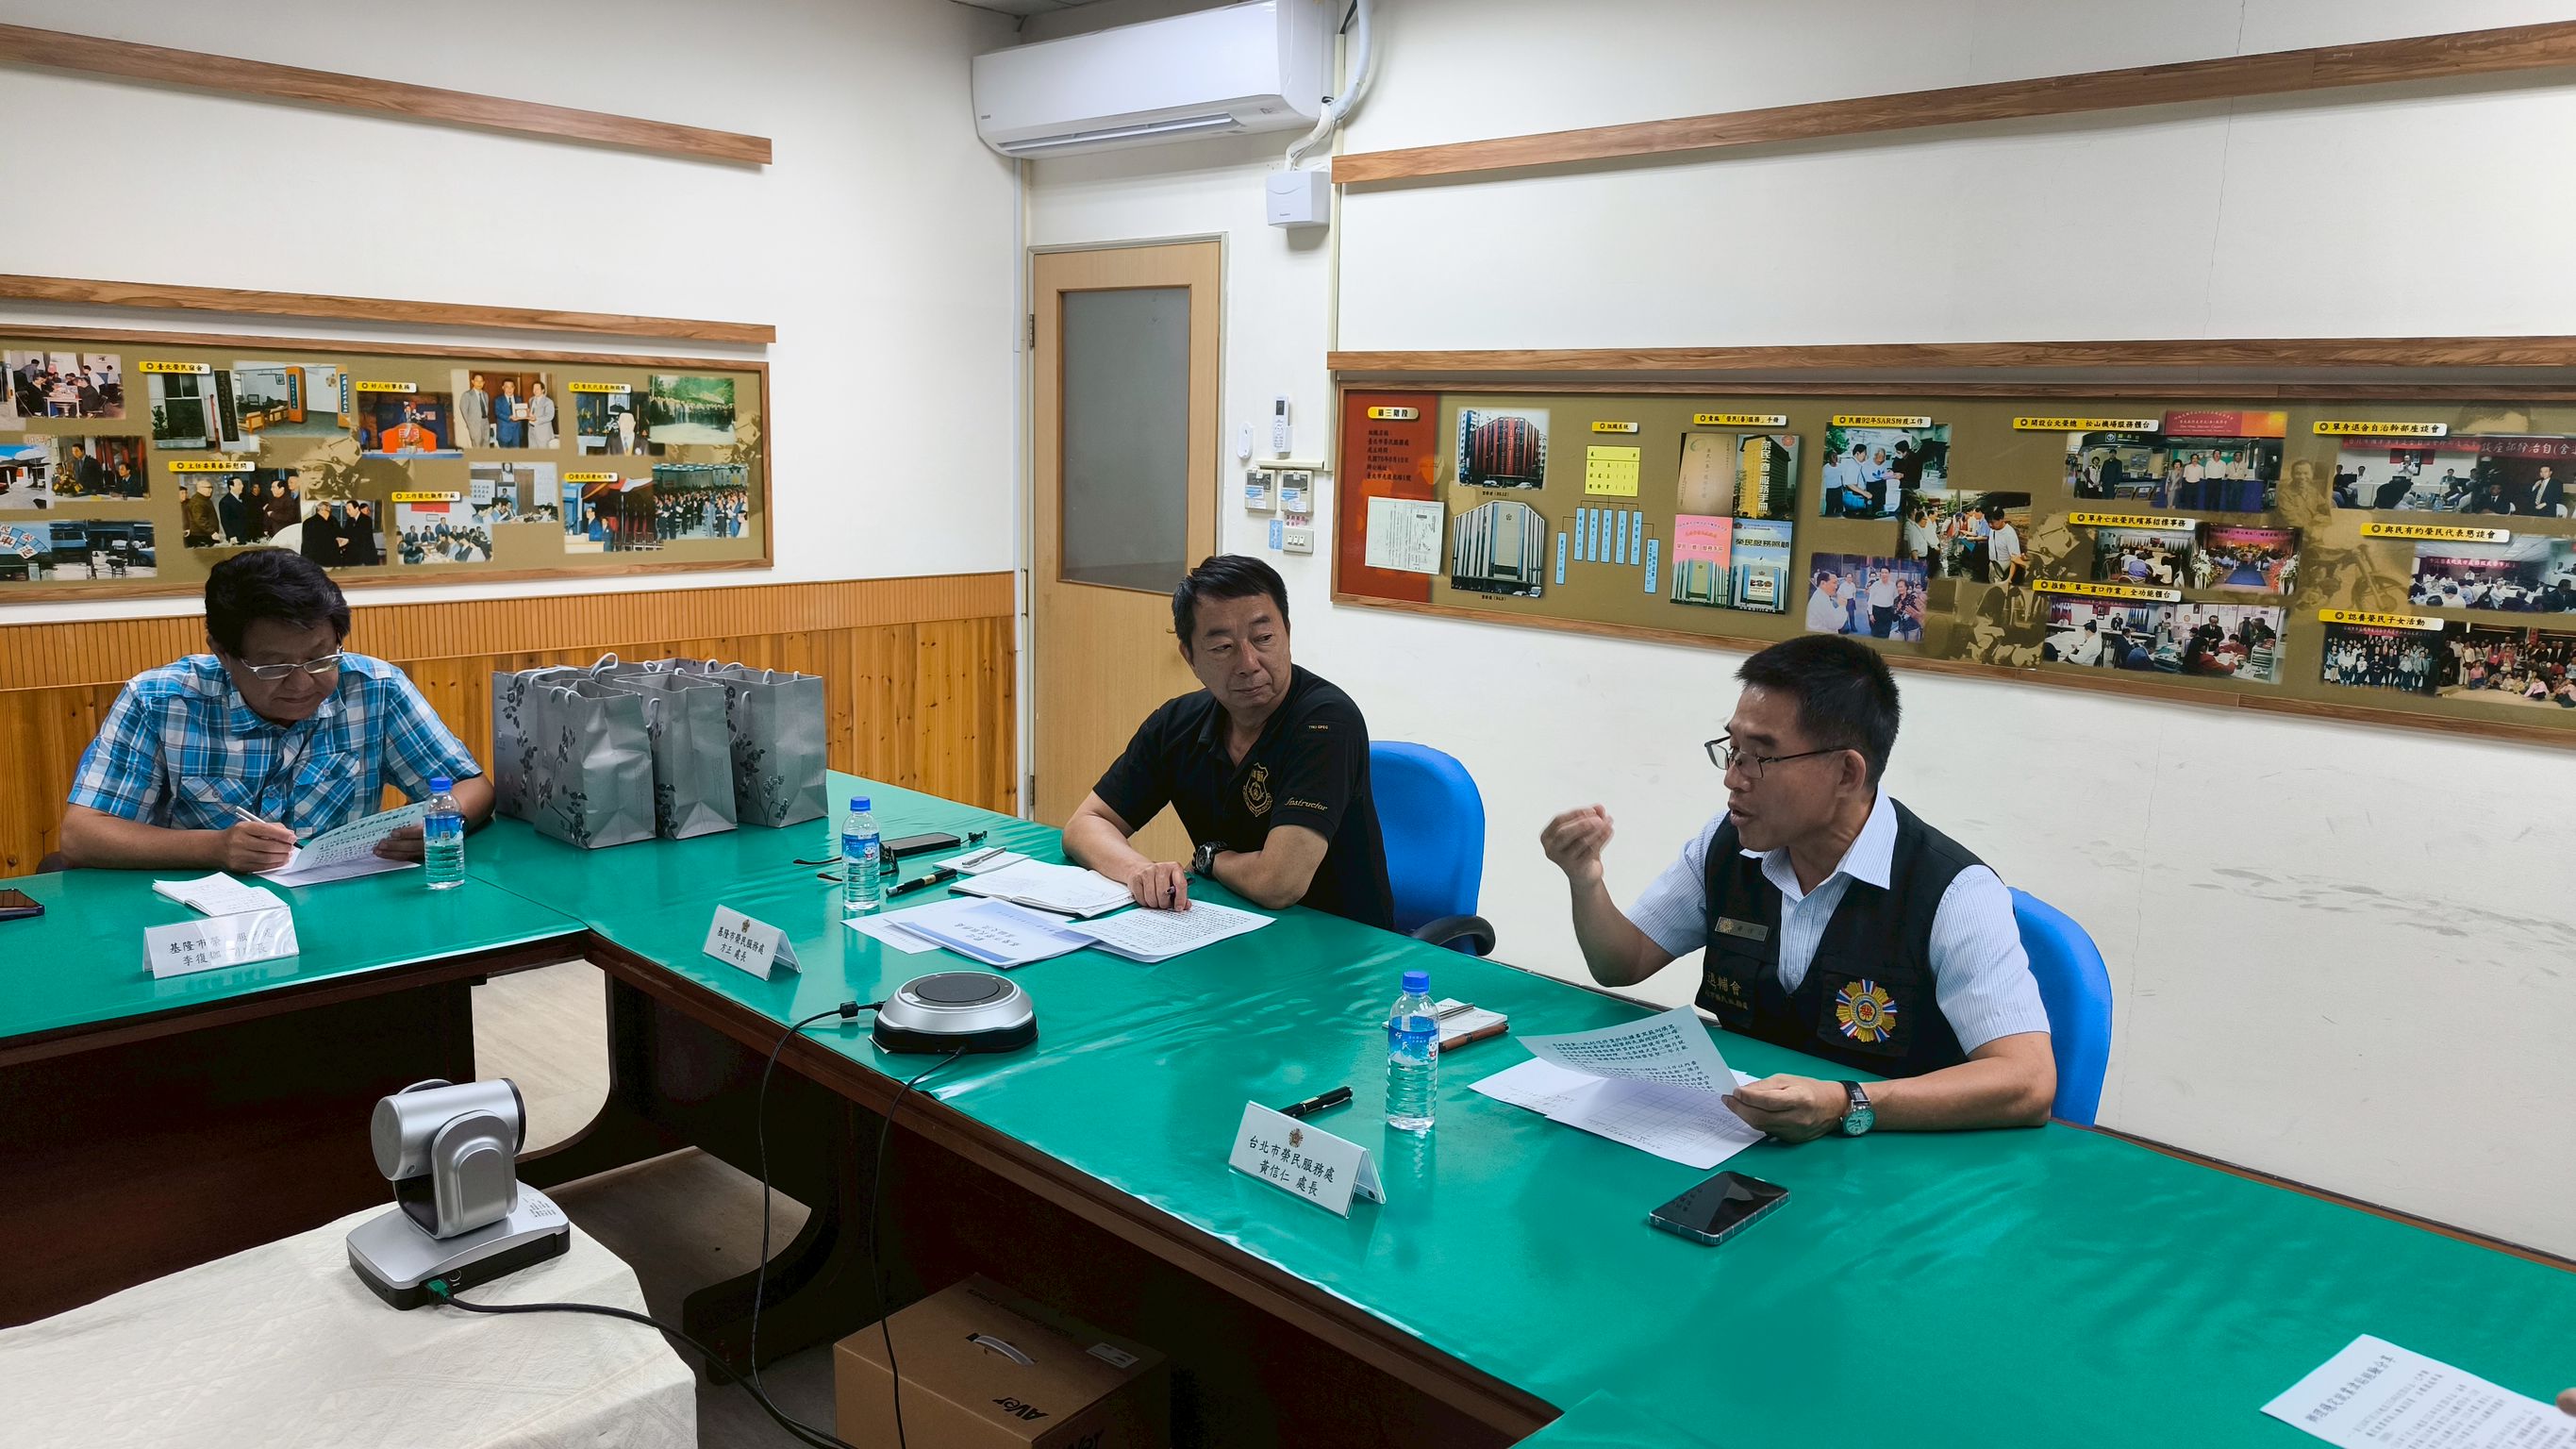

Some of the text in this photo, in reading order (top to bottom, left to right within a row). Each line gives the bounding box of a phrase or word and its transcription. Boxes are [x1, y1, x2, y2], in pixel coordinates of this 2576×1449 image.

[1378, 408, 1408, 417] 第三階段
[1848, 416, 1923, 425] 民國92年SARS防疫工作
[2348, 612, 2426, 627] 認養榮民子女活動
[1284, 796, 1328, 811] Instructor
[717, 925, 765, 956] 基隆市榮民服務處
[1248, 1134, 1336, 1184] 台北市榮民服務處
[1259, 1159, 1319, 1198] 黃信仁 處長
